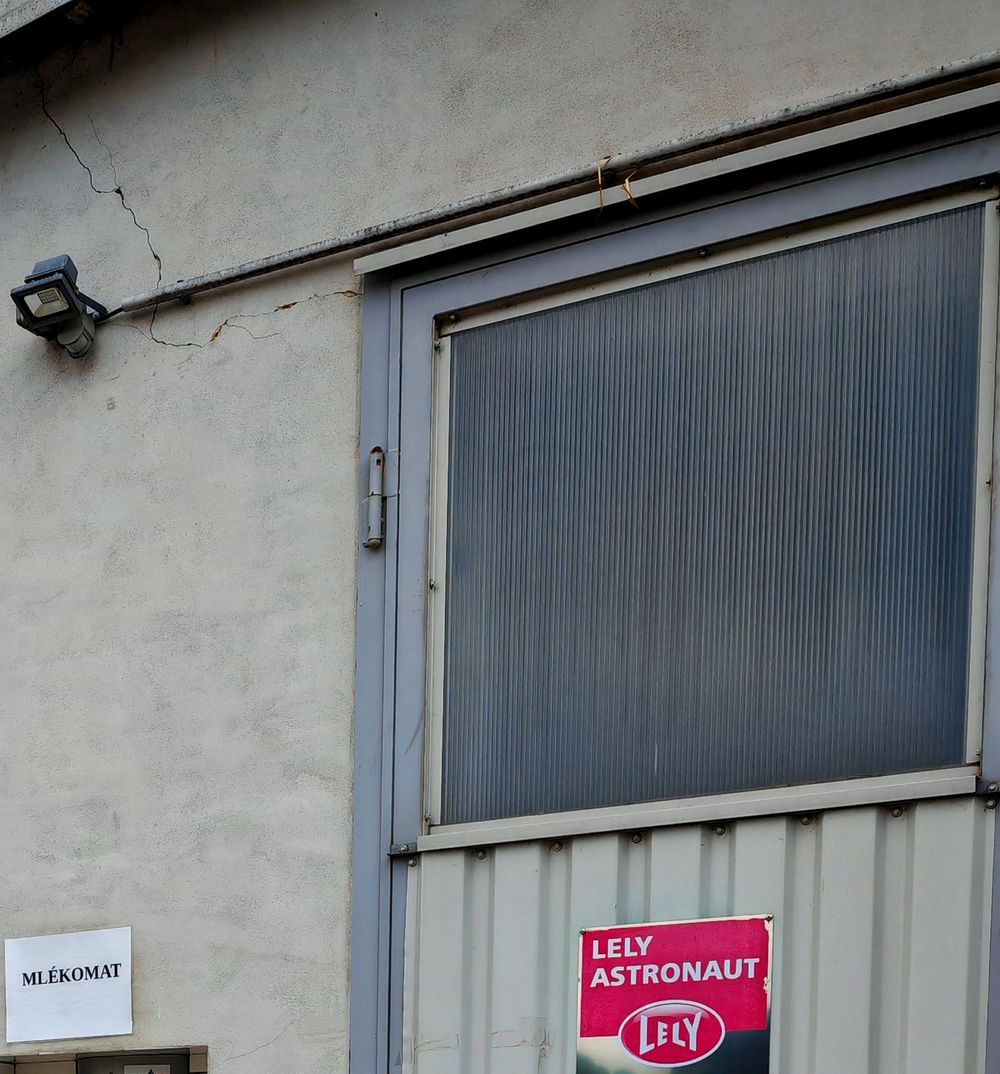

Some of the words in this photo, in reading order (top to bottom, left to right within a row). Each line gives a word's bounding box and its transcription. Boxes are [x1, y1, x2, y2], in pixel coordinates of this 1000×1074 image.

[592, 935, 653, 959] LELY
[22, 963, 122, 987] MLÉKOMAT
[590, 958, 760, 988] ASTRONAUT
[639, 1011, 702, 1055] LELY
